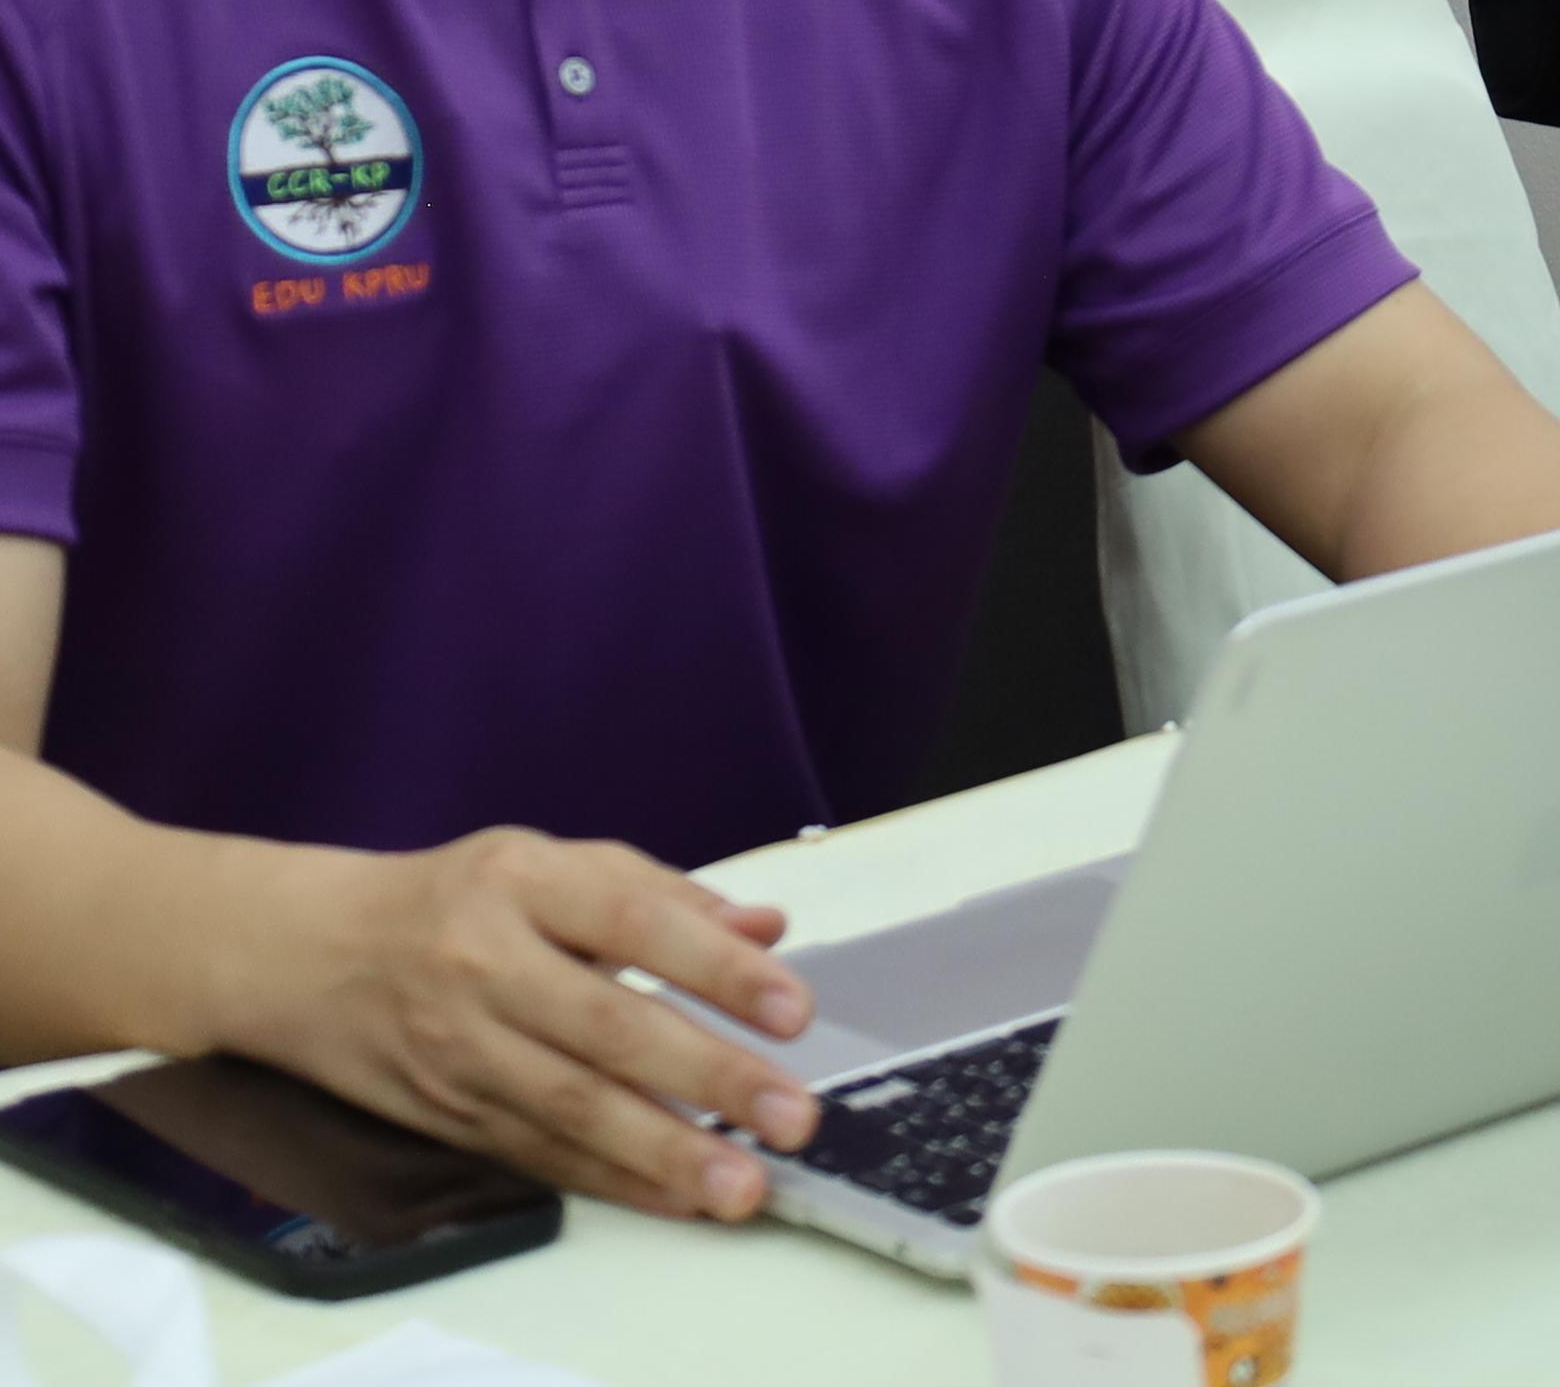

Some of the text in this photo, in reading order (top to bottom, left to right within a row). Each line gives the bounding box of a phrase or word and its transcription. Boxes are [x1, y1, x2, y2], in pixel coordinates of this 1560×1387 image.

[266, 161, 392, 199] CCR-KP
[251, 261, 431, 314] EDU KPRU
